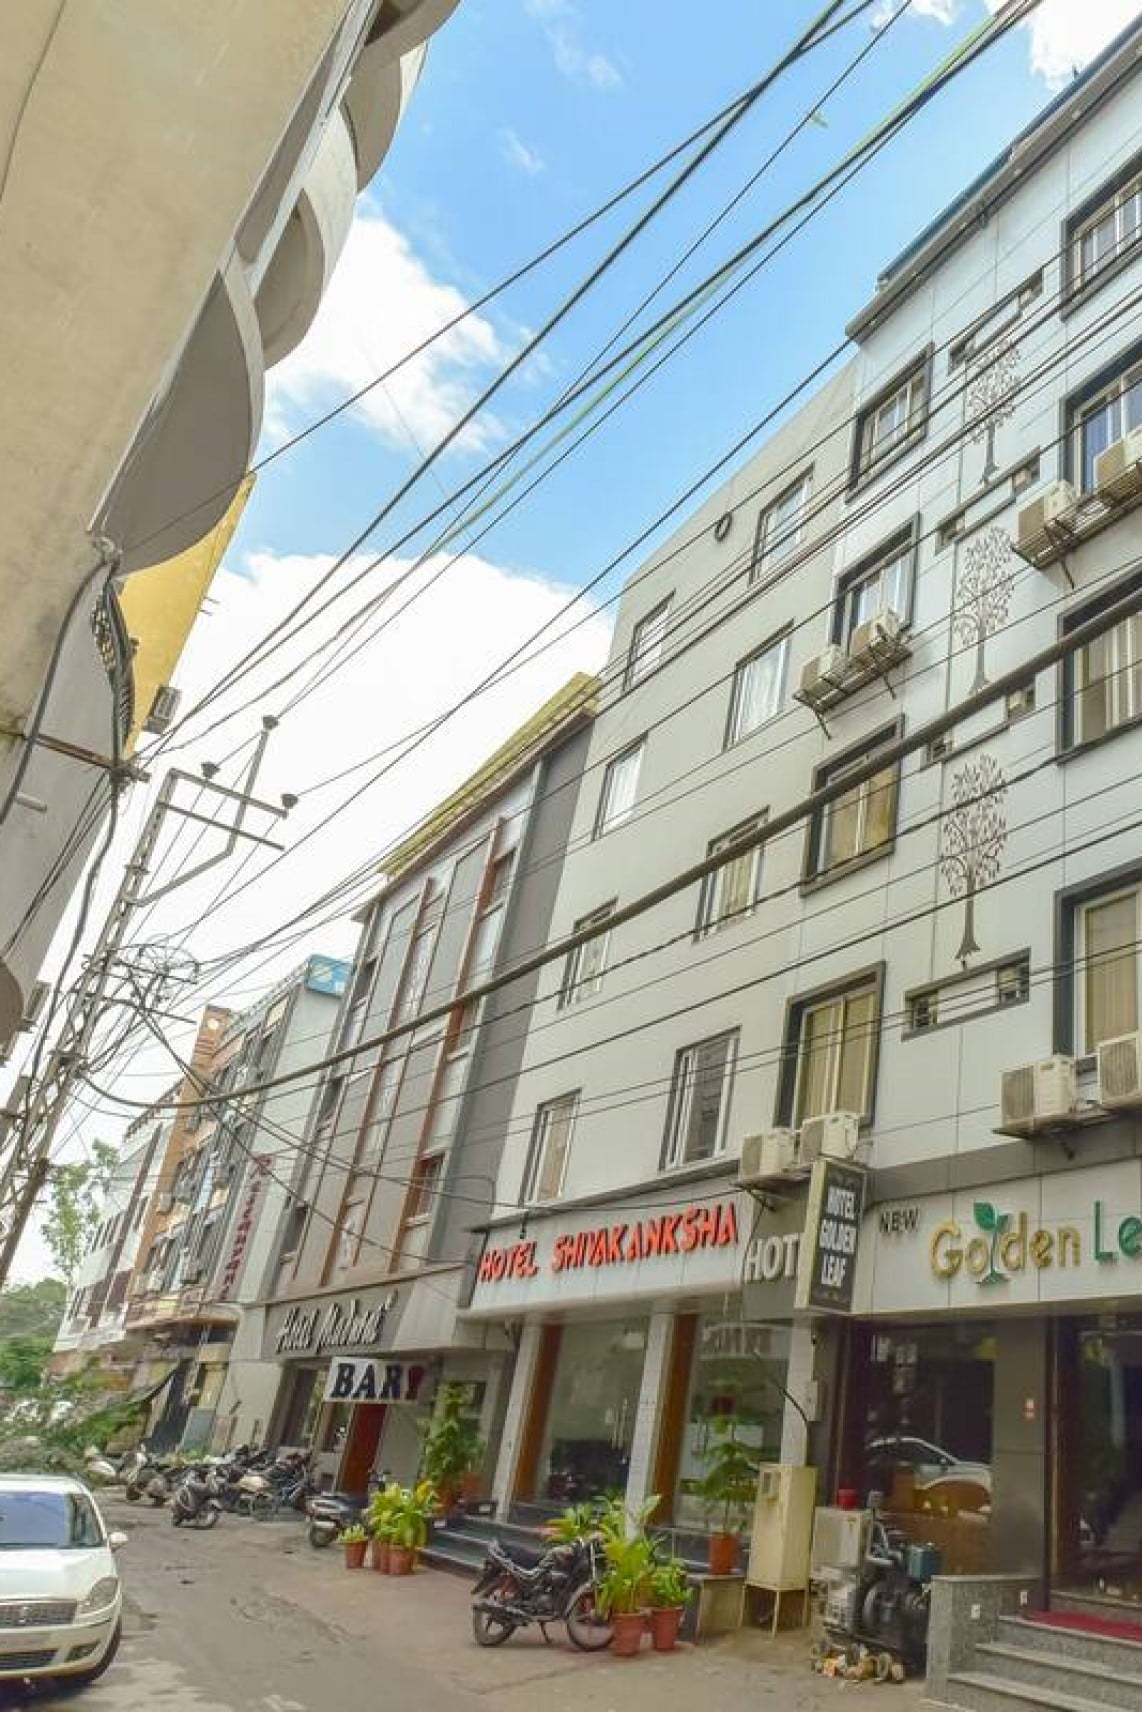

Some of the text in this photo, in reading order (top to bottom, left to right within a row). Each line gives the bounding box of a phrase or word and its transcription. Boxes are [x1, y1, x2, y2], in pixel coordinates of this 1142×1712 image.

[827, 1186, 856, 1219] HOTEL
[478, 1202, 738, 1284] HOTEL SHIVAKANKSHA
[820, 1219, 857, 1253] GOLDEN
[879, 1207, 921, 1234] NEW
[929, 1202, 1082, 1285] Golden
[821, 1254, 847, 1287] LEAF
[331, 1362, 402, 1399] BAR
